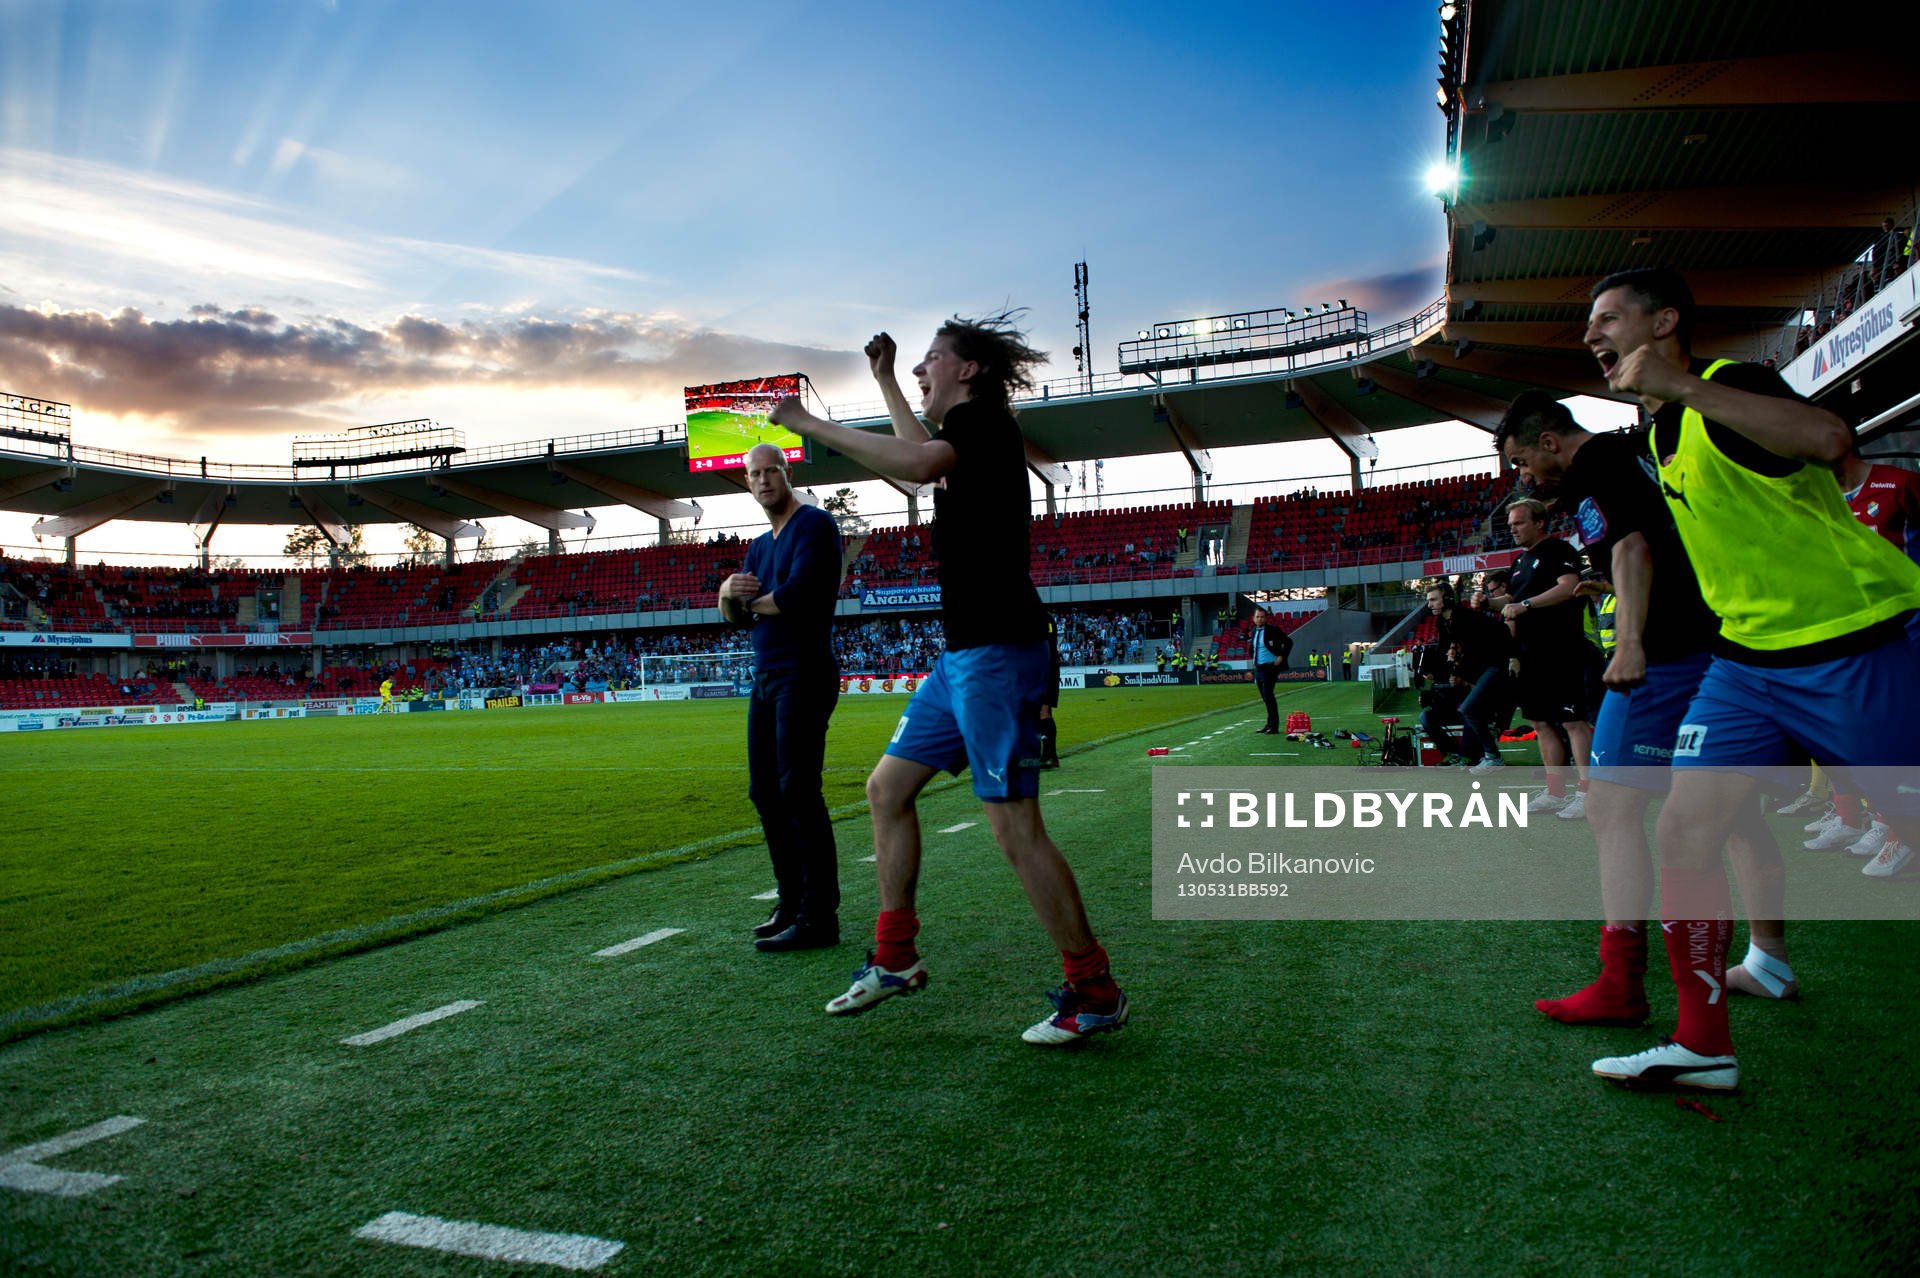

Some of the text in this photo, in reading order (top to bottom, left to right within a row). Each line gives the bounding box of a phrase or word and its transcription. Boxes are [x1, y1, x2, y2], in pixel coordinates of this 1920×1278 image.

[1829, 302, 1893, 368] Myresjöhus
[1442, 556, 1475, 574] PUMA
[875, 585, 942, 596] Supporterklubb
[863, 590, 941, 605] ÄNGLARN
[47, 635, 93, 645] Myresjöhus
[156, 634, 190, 647] PUMA
[245, 633, 279, 645] PUMA
[1124, 674, 1179, 685] SmålandsVillan
[1200, 670, 1242, 682] Swedbank
[1276, 669, 1315, 680] wedbank
[486, 696, 519, 709] TRAILER
[353, 705, 373, 714] TIPS
[1678, 731, 1699, 751] ut
[1687, 921, 1710, 965] VIKING
